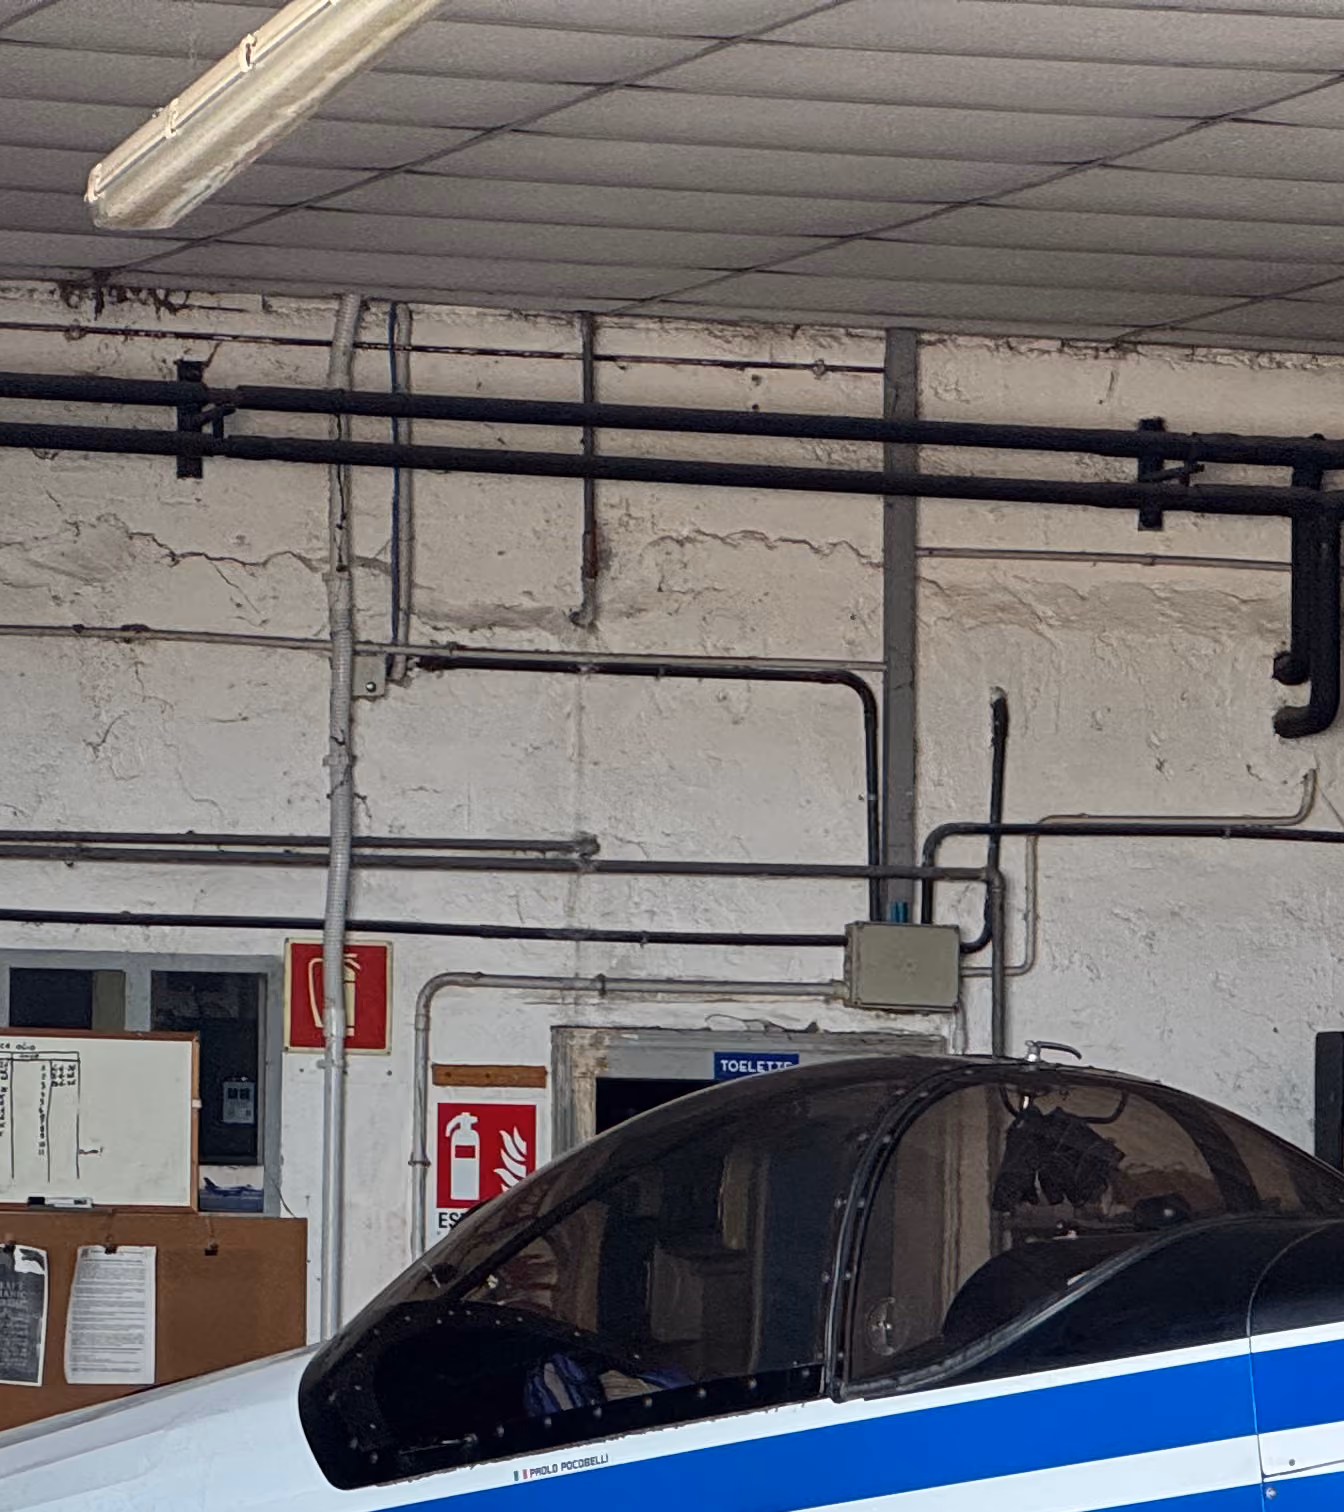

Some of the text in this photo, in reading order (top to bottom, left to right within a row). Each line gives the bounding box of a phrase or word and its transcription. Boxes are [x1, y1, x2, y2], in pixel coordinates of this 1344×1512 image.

[438, 1211, 465, 1230] ES
[529, 1454, 610, 1479] PAOLO POCOBELLI
